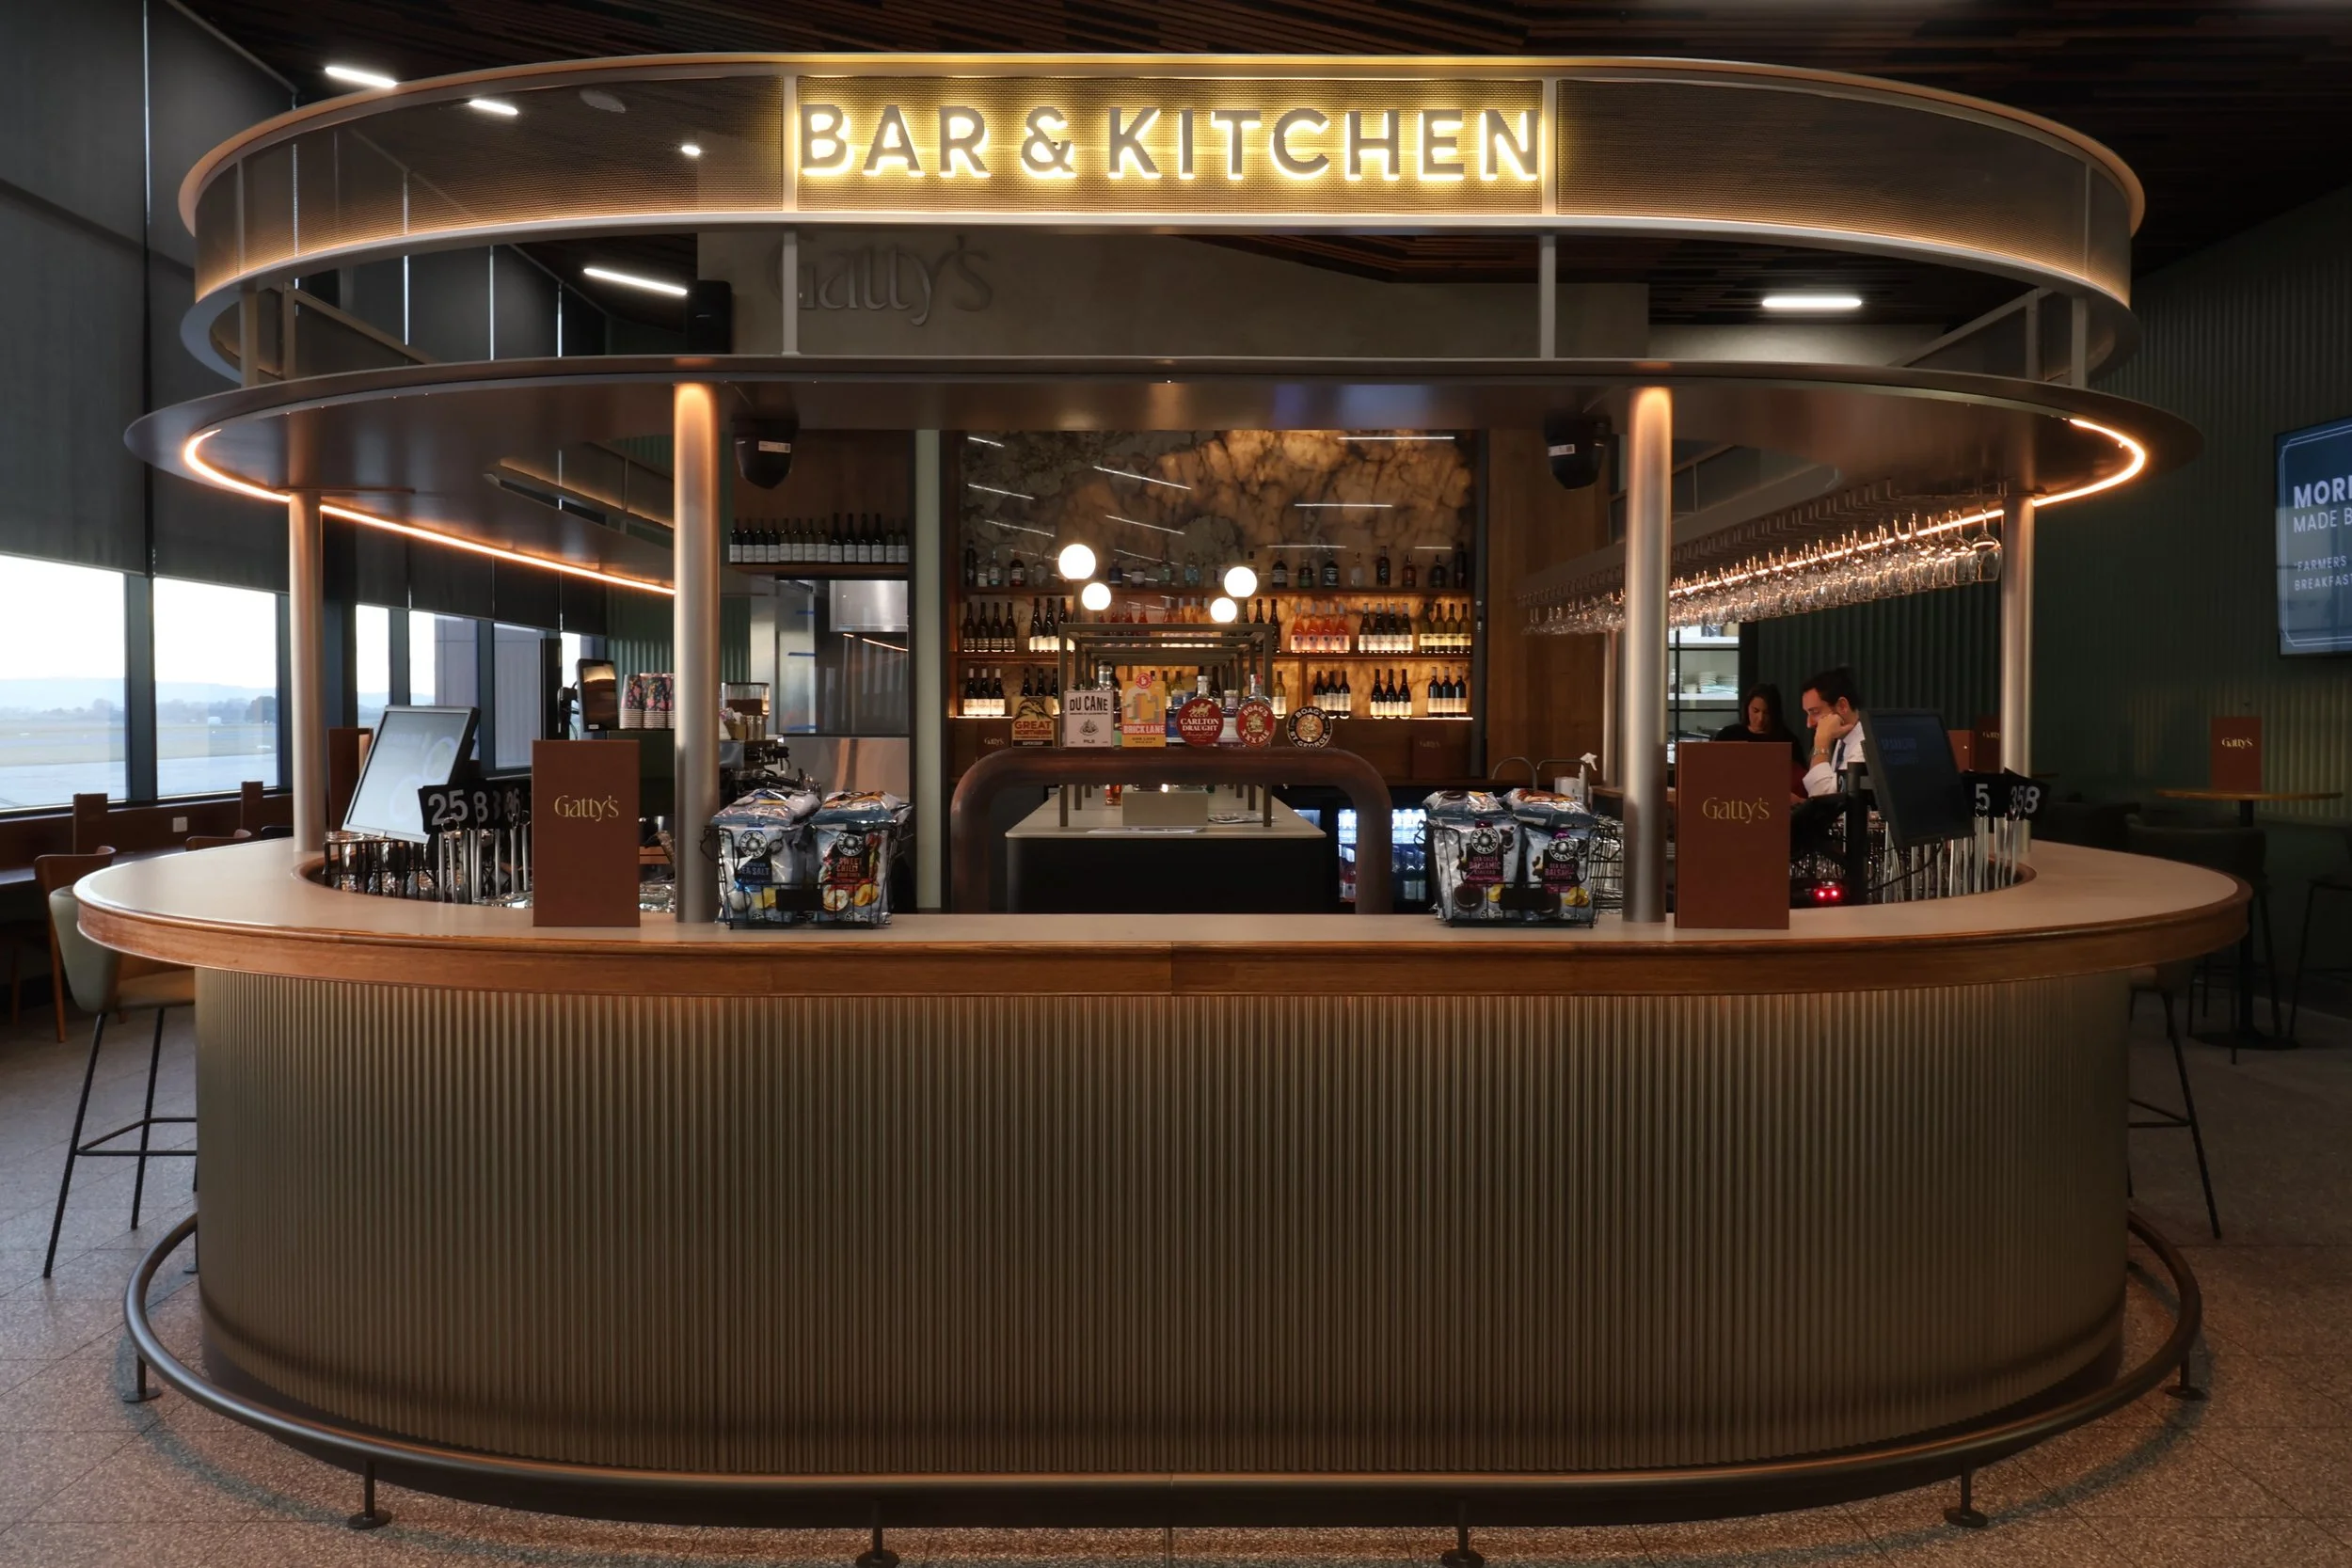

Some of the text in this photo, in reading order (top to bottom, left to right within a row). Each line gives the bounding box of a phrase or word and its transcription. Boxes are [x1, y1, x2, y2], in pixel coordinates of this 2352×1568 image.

[801, 104, 1539, 182] BAR & KITCHEN
[2293, 474, 2352, 510] MOR
[2293, 510, 2338, 533] MADE
[1070, 696, 1108, 711] DU CANE
[1243, 705, 1269, 717] BOAG'S
[1295, 707, 1327, 720] BOAG'S
[1014, 721, 1052, 729] GREAT
[1123, 724, 1165, 734] BRICK LANE
[1241, 729, 1270, 744] XXX ALE
[1290, 731, 1330, 748] ST GEORGE
[2221, 737, 2253, 749] Gatty's
[1975, 783, 1990, 811] 5
[428, 789, 469, 826] 25
[554, 794, 619, 822] Gatty's
[1702, 797, 1770, 823] Gatty's
[1477, 844, 1494, 853] DELI
[839, 857, 862, 866] SWEET
[1469, 861, 1502, 870] BALSAMIC
[752, 866, 770, 876] SALT
